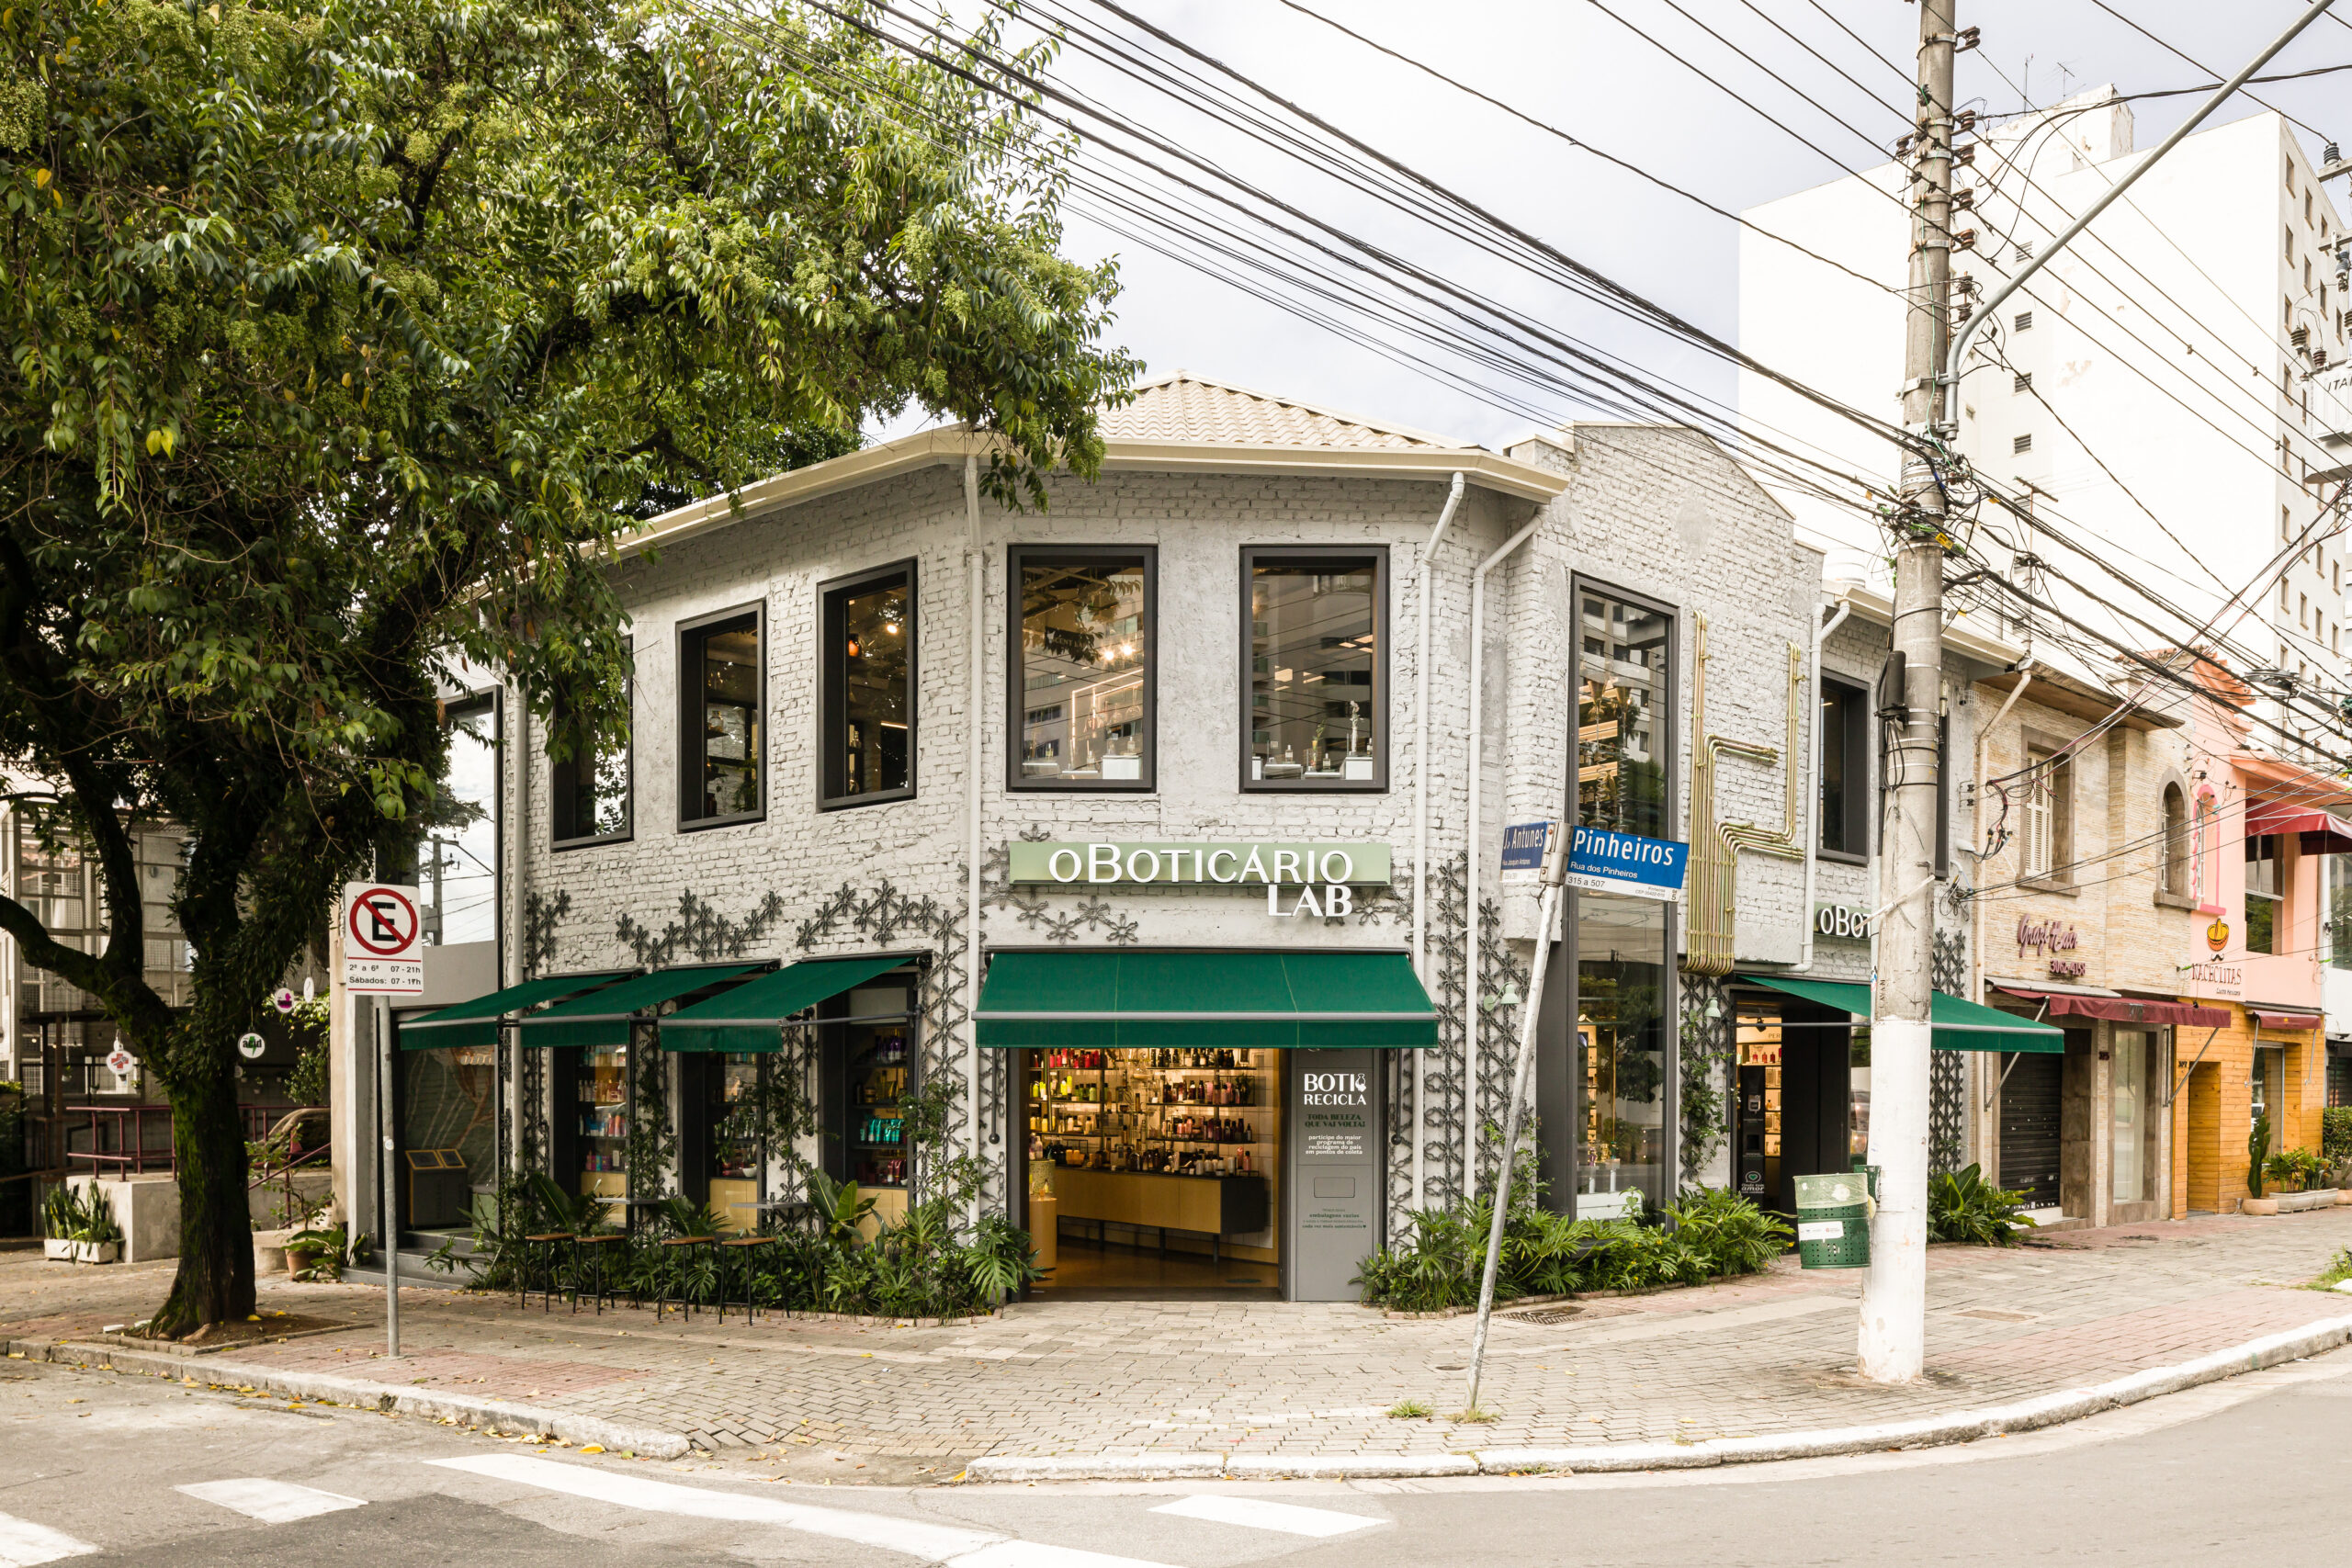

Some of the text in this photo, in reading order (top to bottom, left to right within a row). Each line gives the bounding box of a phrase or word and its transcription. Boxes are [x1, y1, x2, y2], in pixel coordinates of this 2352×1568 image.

[2327, 376, 2352, 392] ITA
[1511, 827, 1544, 850] Antunes
[1573, 829, 1674, 866] Pinheiros
[1570, 861, 1638, 879] Rua dos Pinheiros
[1567, 875, 1582, 886] 315
[1590, 877, 1605, 887] 507
[1267, 885, 1353, 918] LAB
[1304, 1093, 1367, 1106] RECICLA
